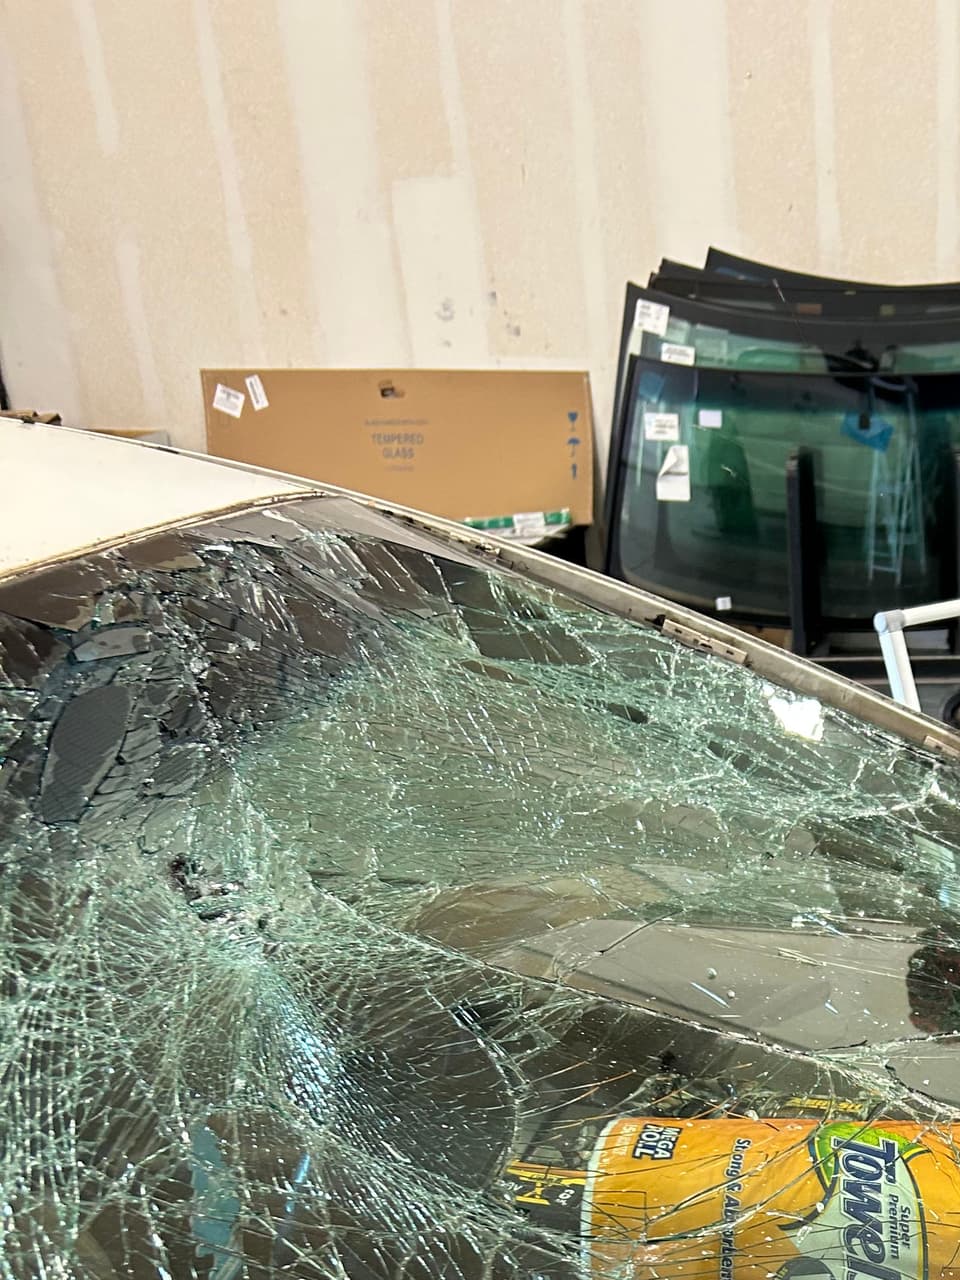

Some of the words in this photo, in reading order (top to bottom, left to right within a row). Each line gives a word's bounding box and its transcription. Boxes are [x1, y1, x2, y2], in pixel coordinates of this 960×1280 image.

[371, 432, 424, 446] TEMPERED
[383, 447, 415, 459] GLASS
[634, 1123, 663, 1159] ROLL
[654, 1126, 680, 1159] MEGA
[888, 1193, 899, 1259] Premium
[900, 1205, 911, 1249] Super
